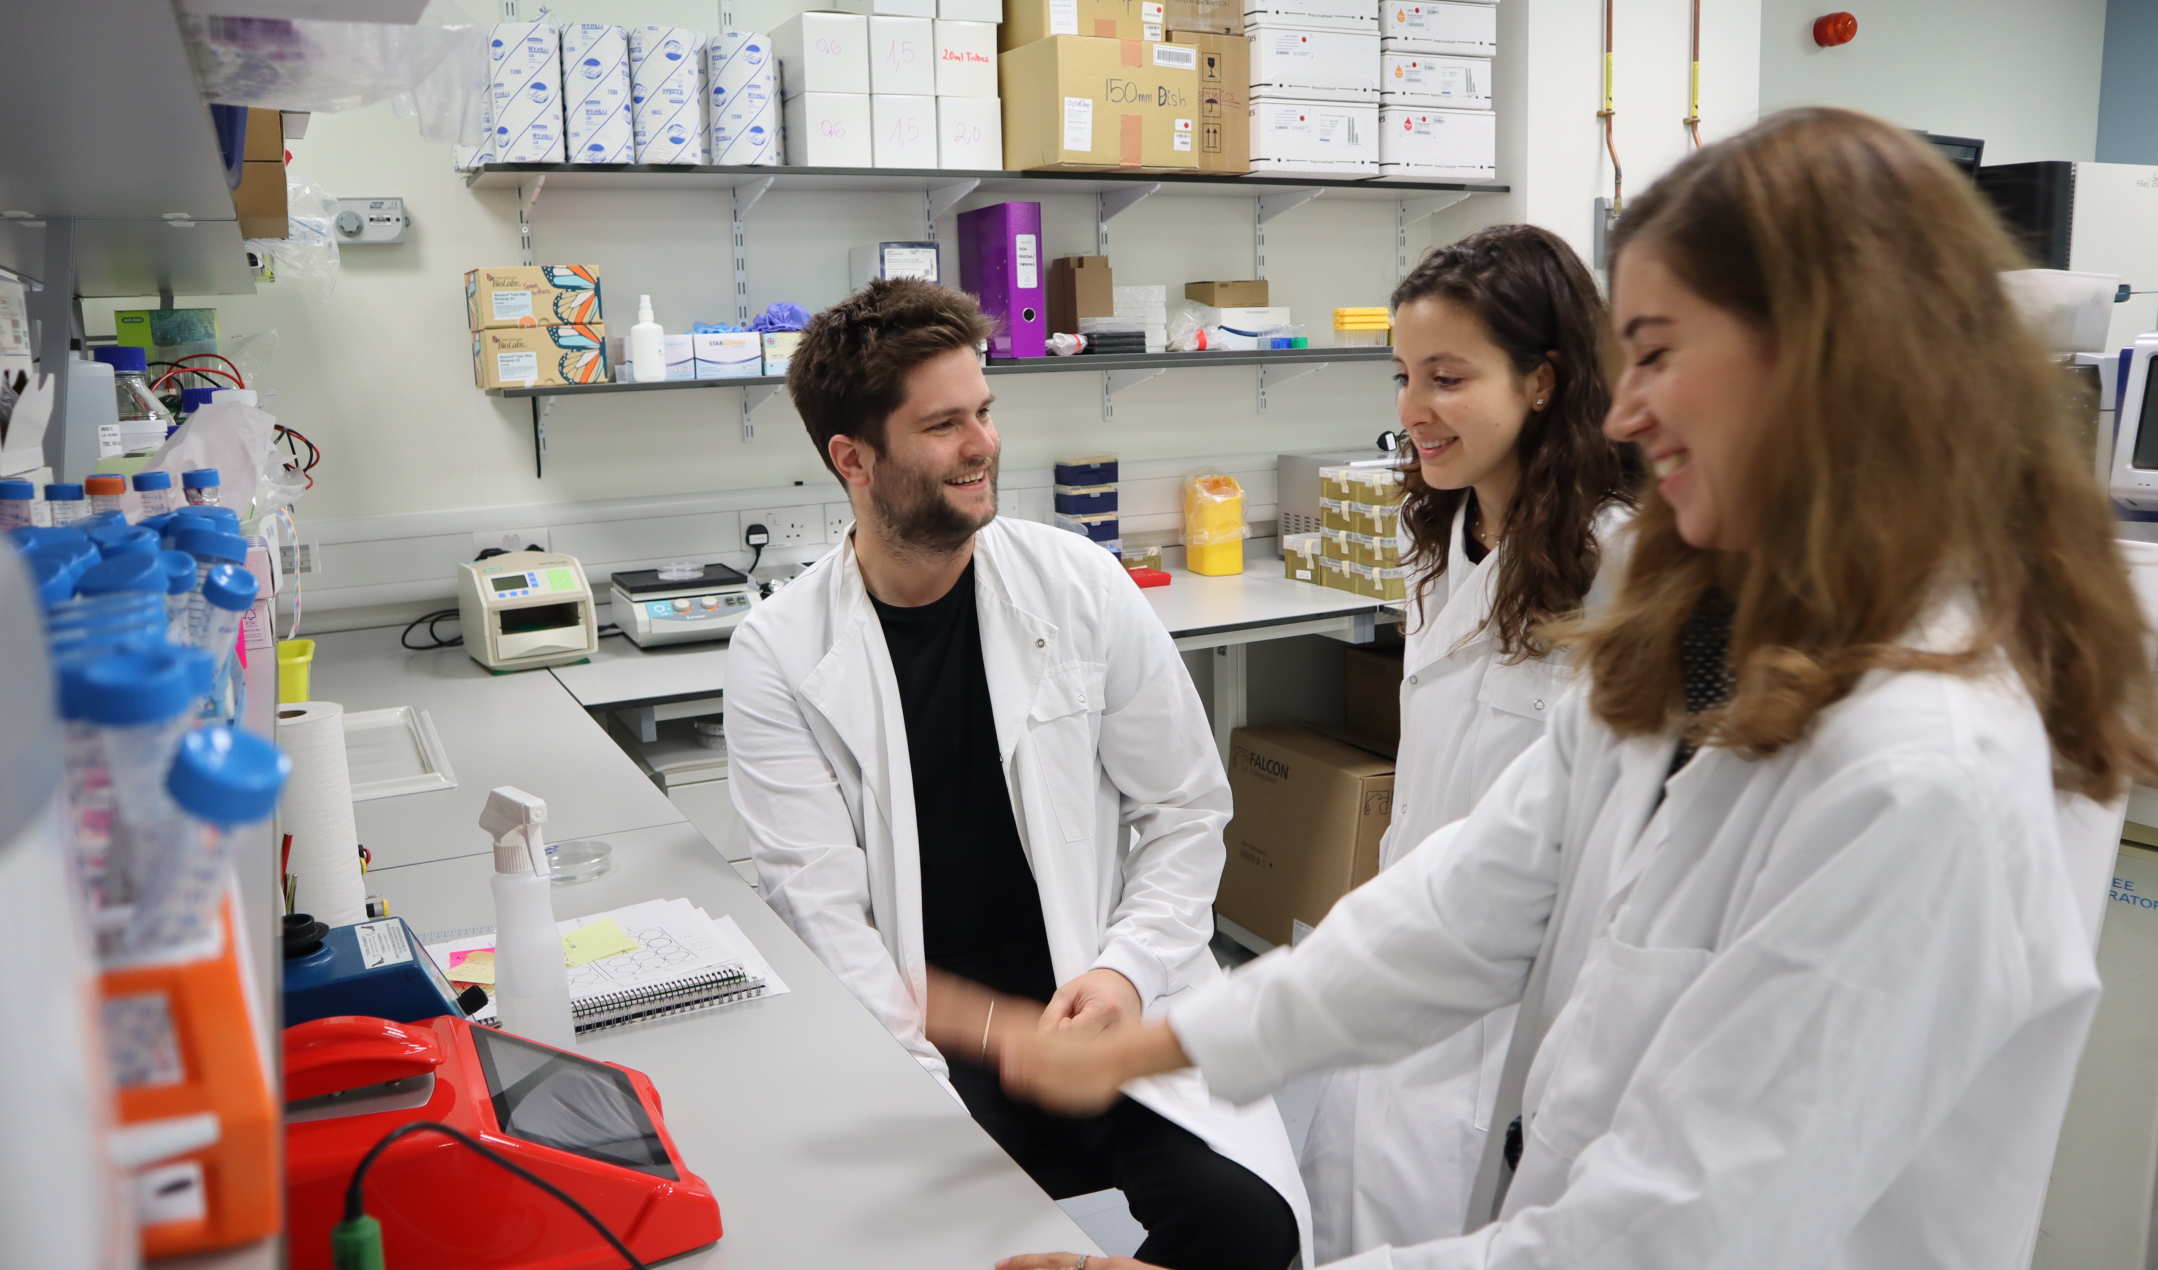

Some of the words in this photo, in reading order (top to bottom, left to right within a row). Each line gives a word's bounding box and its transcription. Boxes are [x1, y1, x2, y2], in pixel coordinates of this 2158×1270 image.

[1105, 78, 1152, 103] 150mm
[1158, 86, 1187, 107] Dish
[1249, 752, 1289, 780] FALCON
